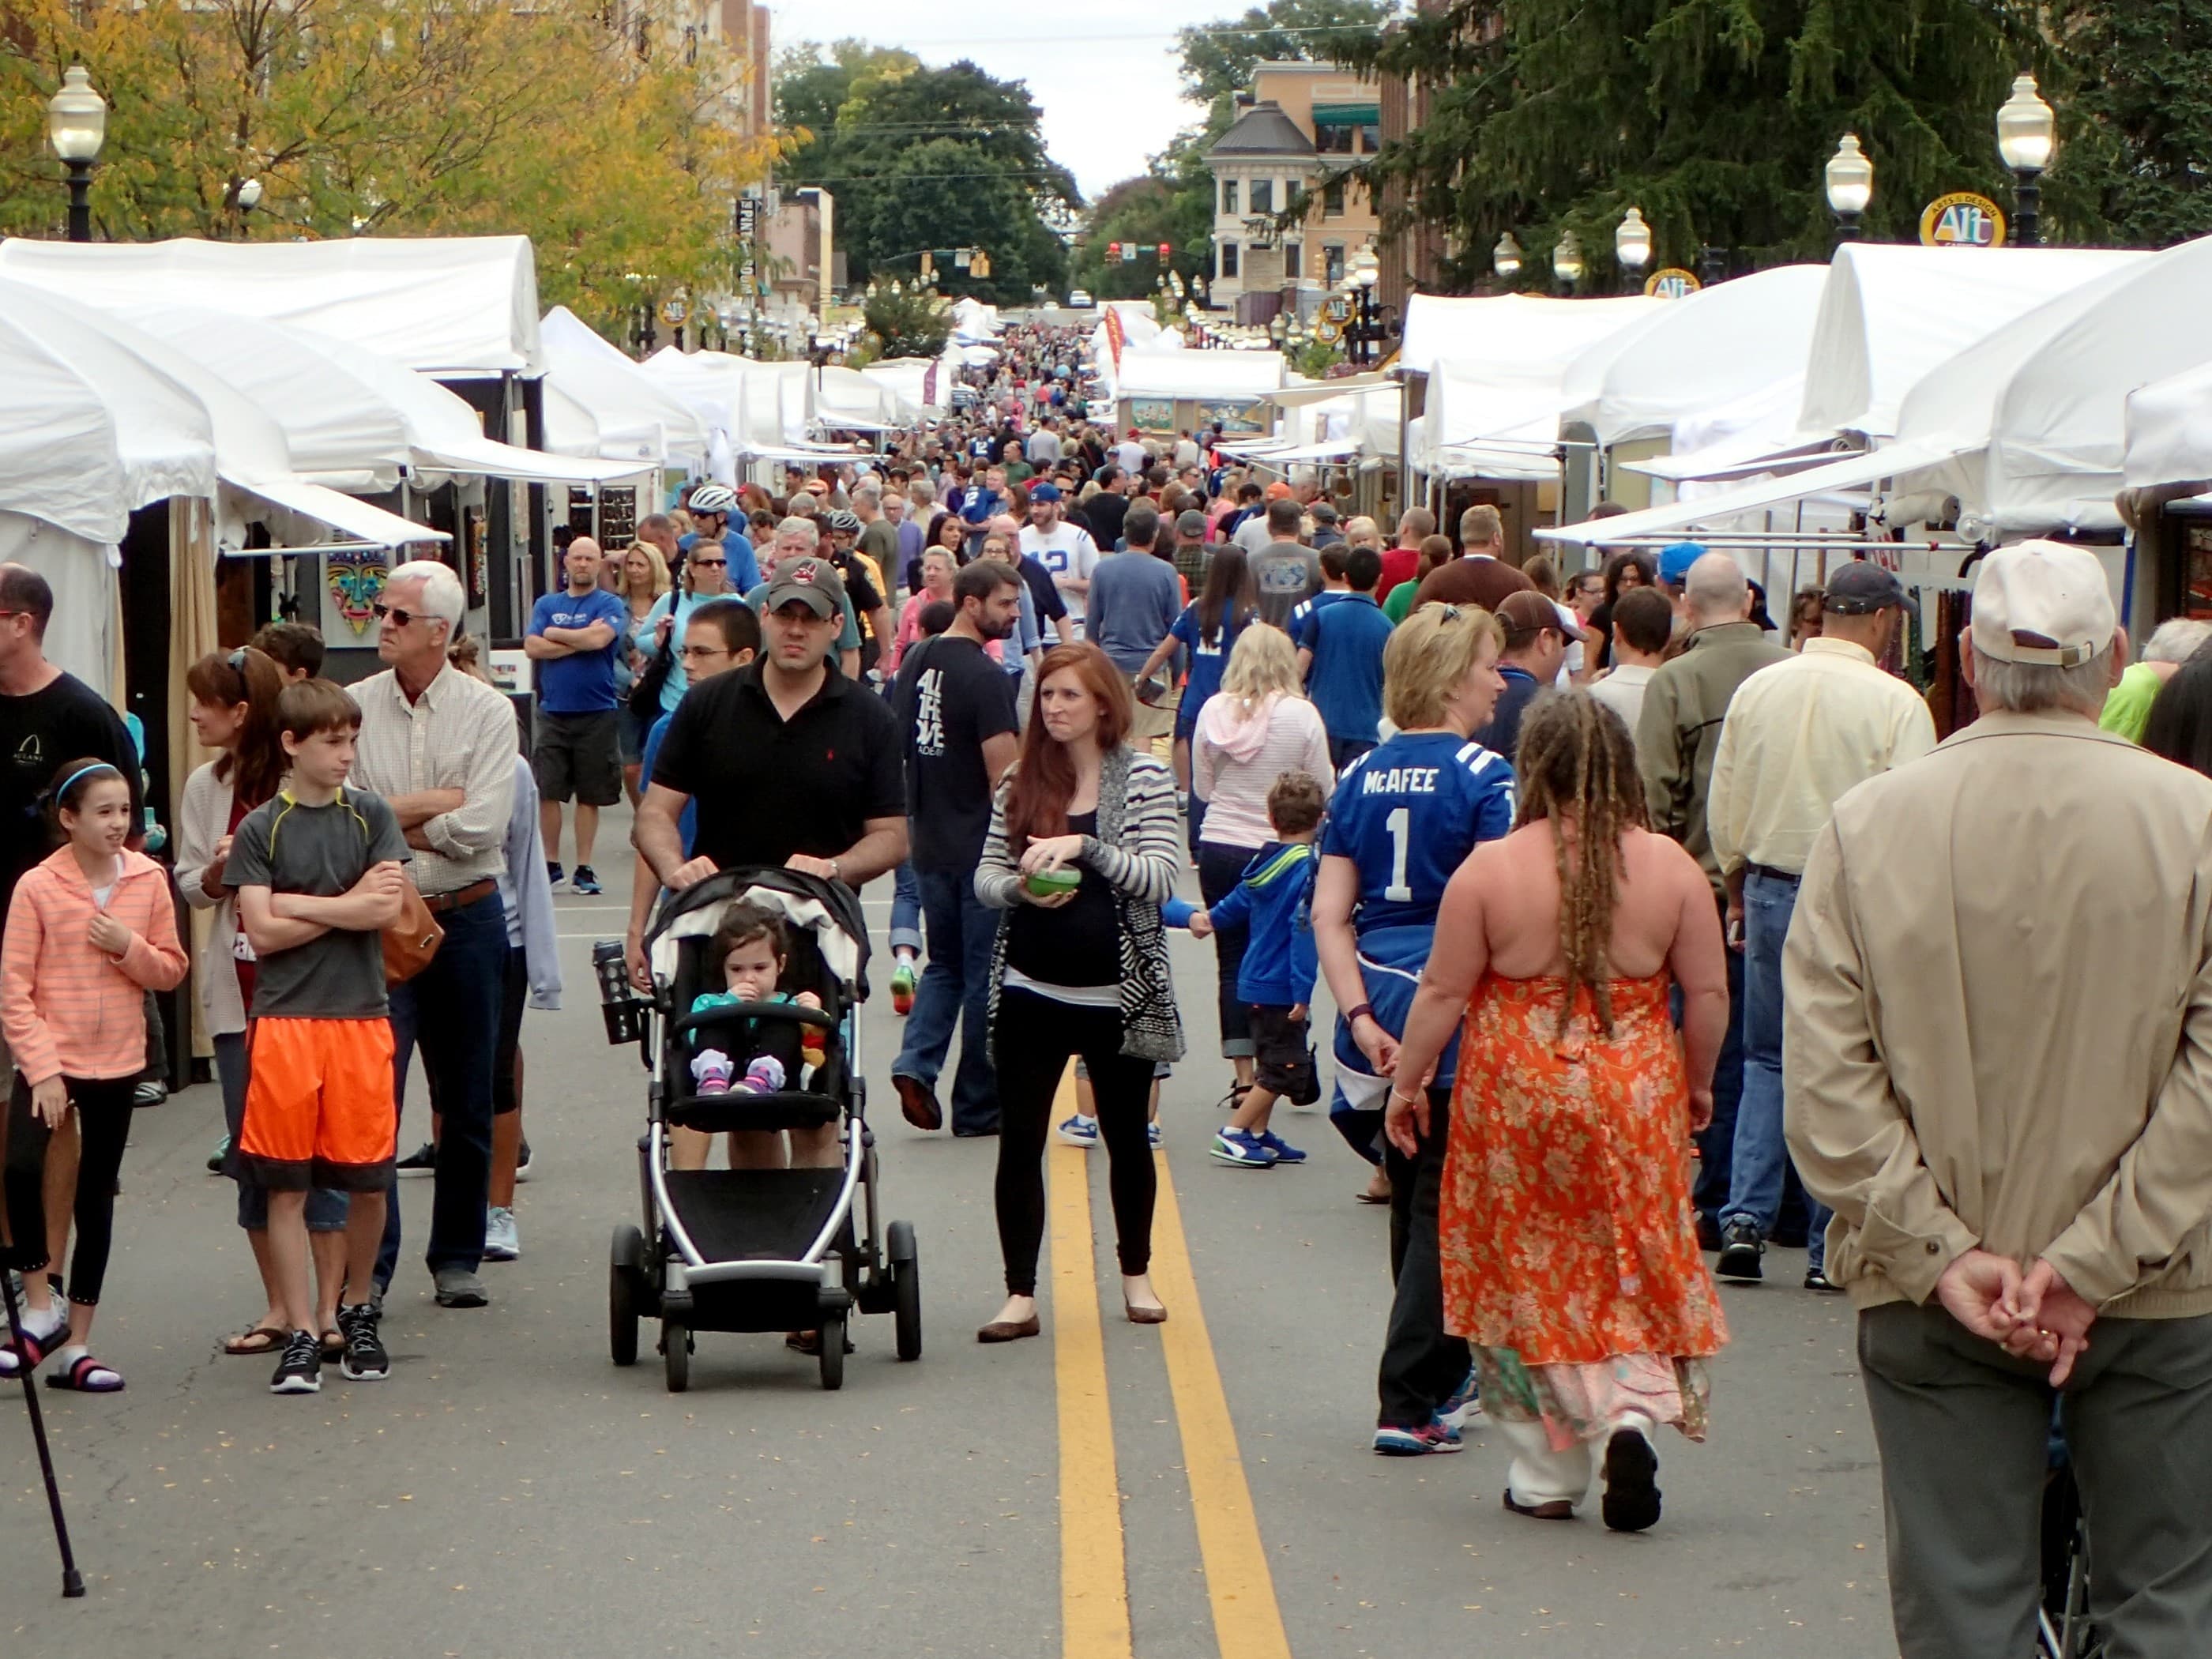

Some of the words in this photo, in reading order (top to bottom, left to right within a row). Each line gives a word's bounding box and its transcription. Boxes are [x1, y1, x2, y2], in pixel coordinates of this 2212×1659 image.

[1932, 197, 1954, 213] ARTS
[1965, 196, 1998, 217] DESIGN
[976, 442, 988, 454] 12
[965, 491, 979, 507] 12
[1385, 808, 1413, 901] 1
